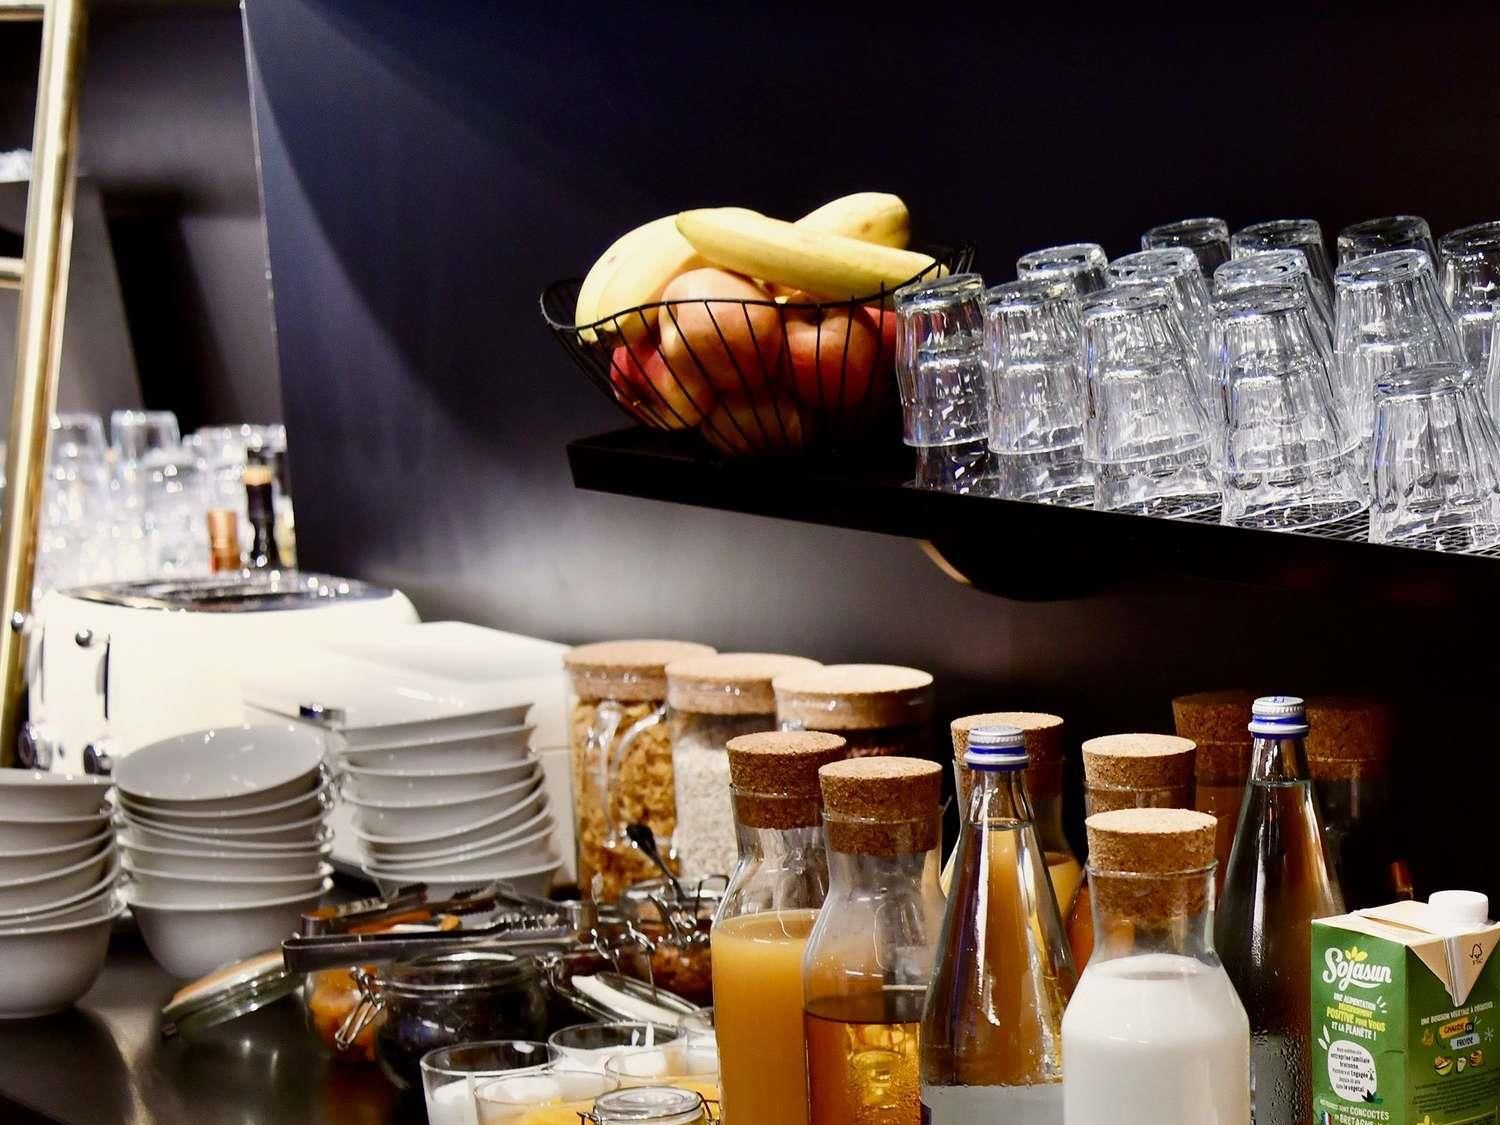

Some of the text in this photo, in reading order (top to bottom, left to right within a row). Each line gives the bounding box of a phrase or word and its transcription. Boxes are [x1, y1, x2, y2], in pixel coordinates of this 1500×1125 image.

[1322, 947, 1392, 991] Sojasun
[1326, 1006, 1355, 1023] POSITIVE
[1338, 1023, 1345, 1032] LA
